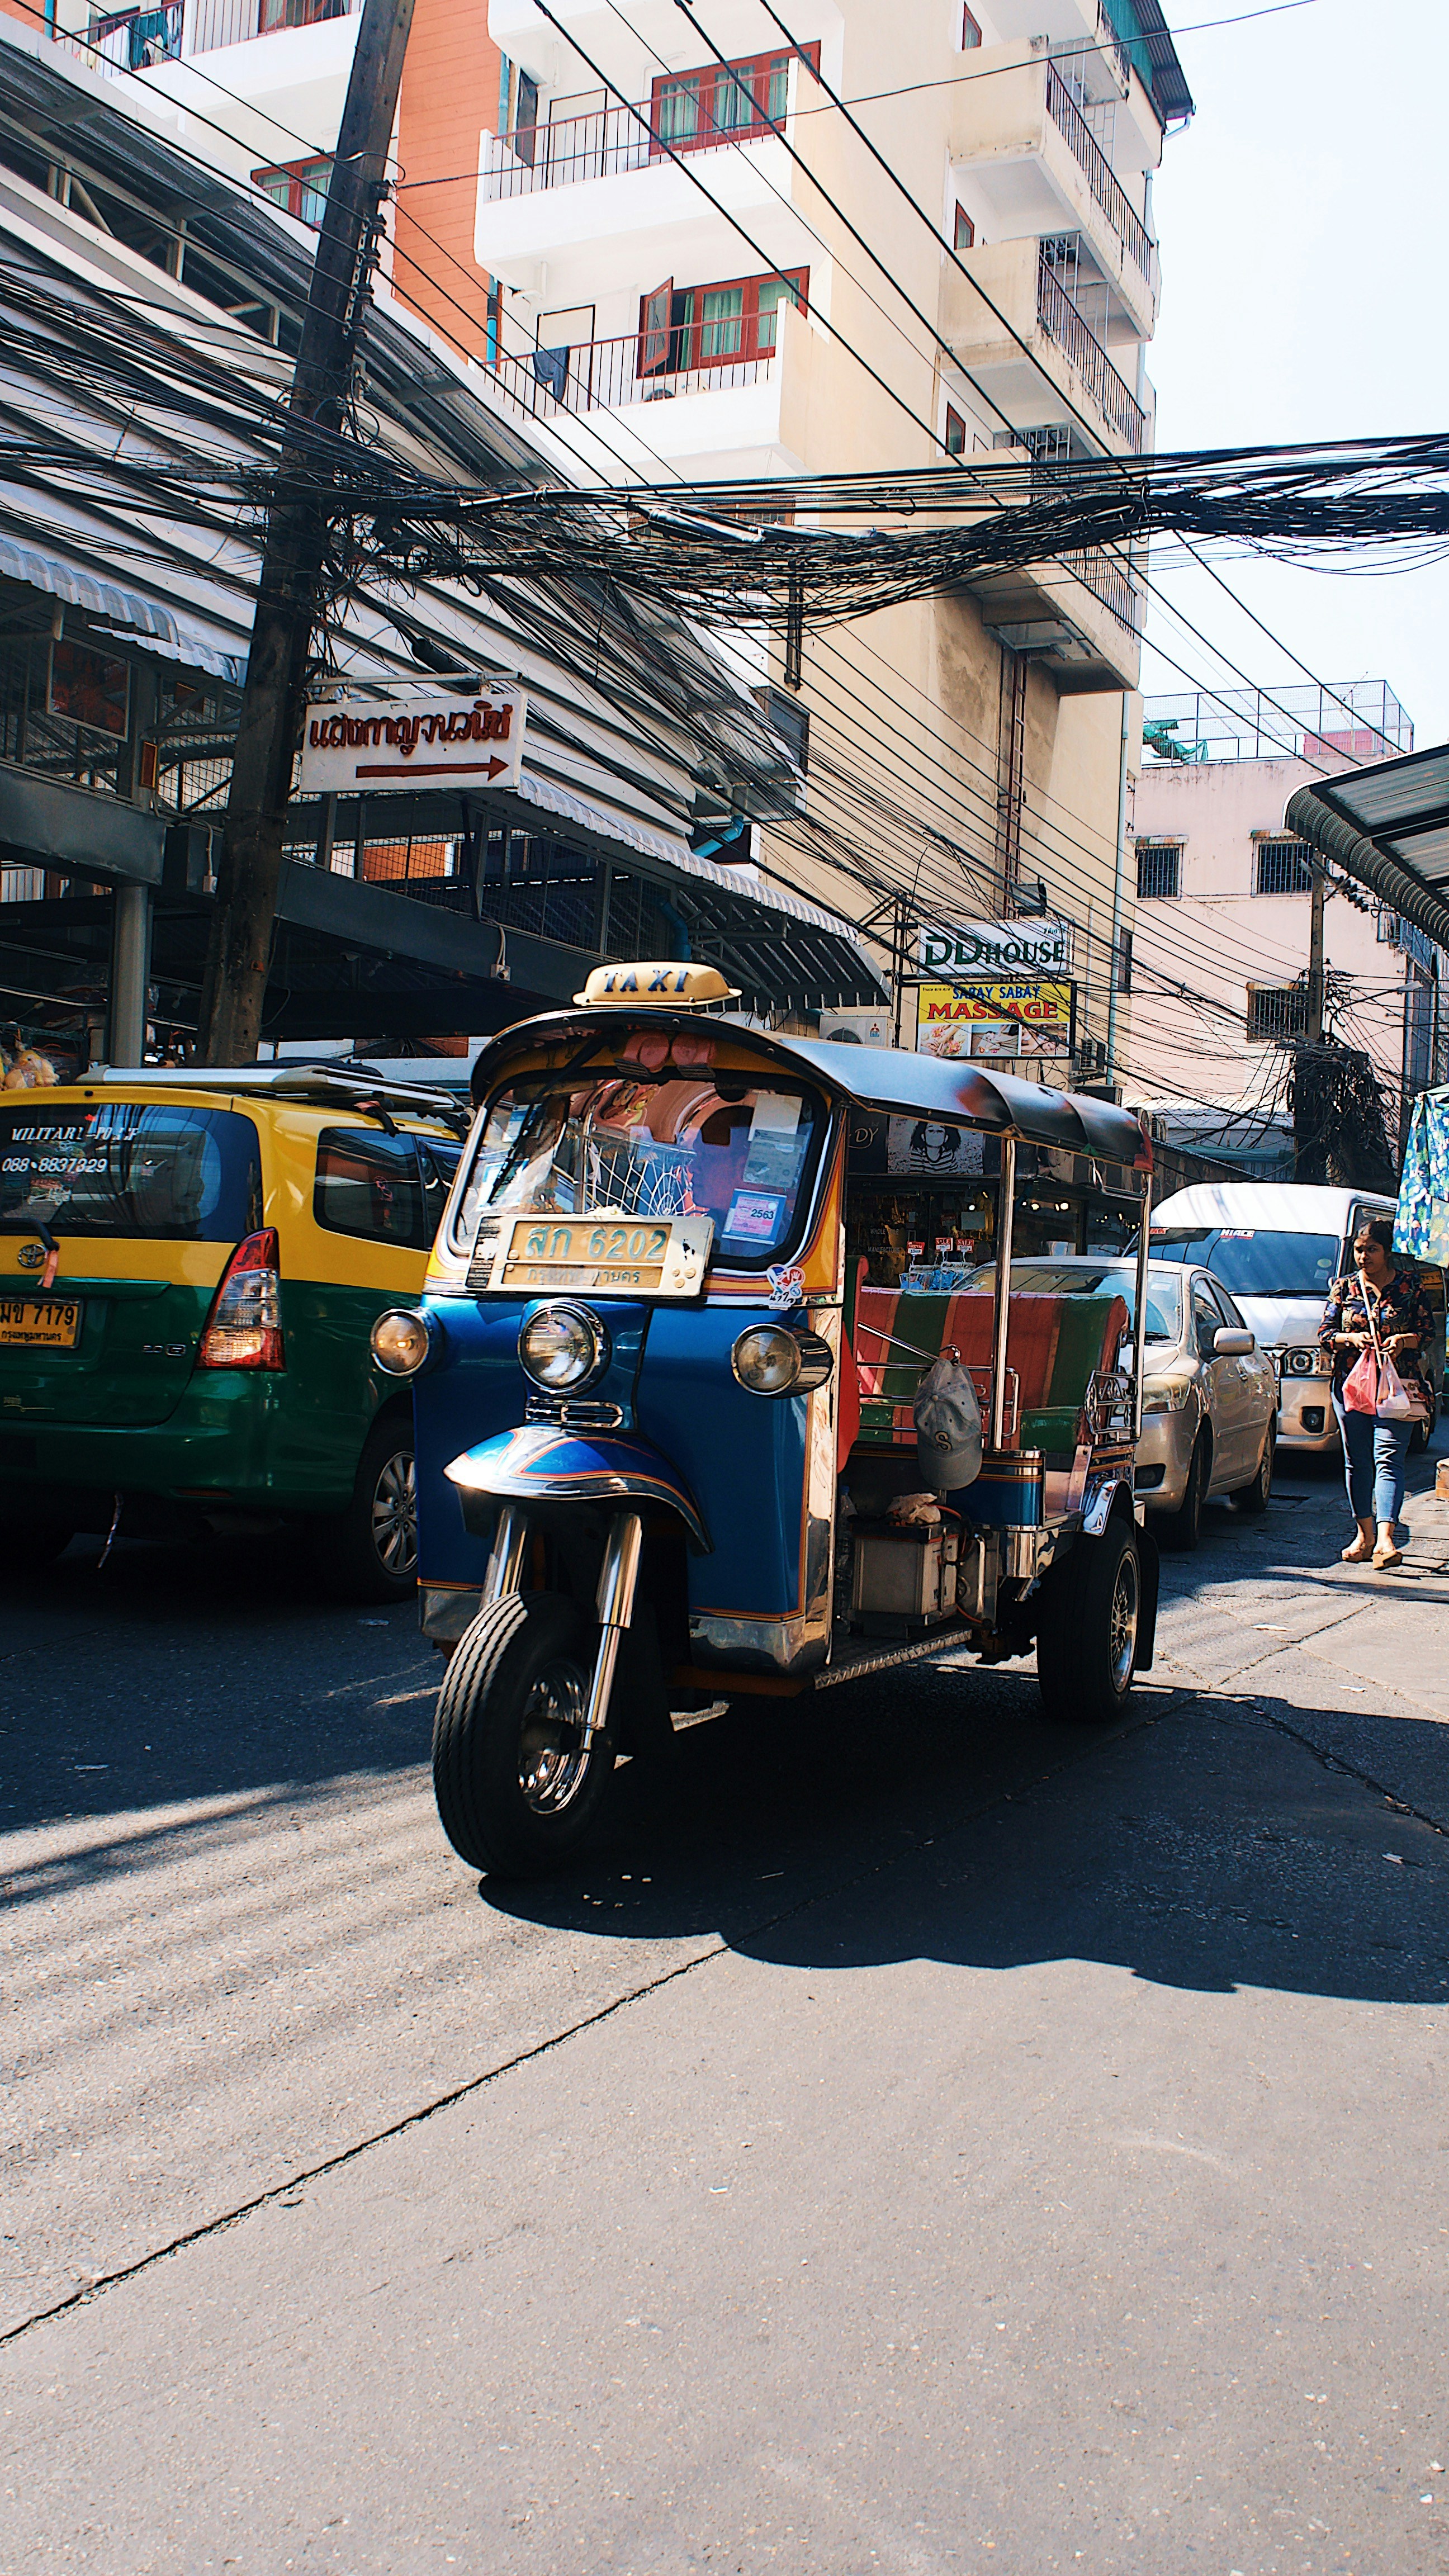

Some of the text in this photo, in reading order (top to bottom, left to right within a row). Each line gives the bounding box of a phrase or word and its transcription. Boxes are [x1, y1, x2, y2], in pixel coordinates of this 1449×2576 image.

[984, 941, 1065, 964] HOUSE
[604, 969, 689, 992] TAXI
[953, 987, 994, 1000] SABAY
[999, 986, 1041, 999] SABAY
[927, 1002, 1058, 1020] MASSAGE
[751, 1209, 774, 1220] 2563
[525, 1227, 667, 1260] สก 6202
[34, 1305, 74, 1325] 7179
[935, 1431, 951, 1451] S
